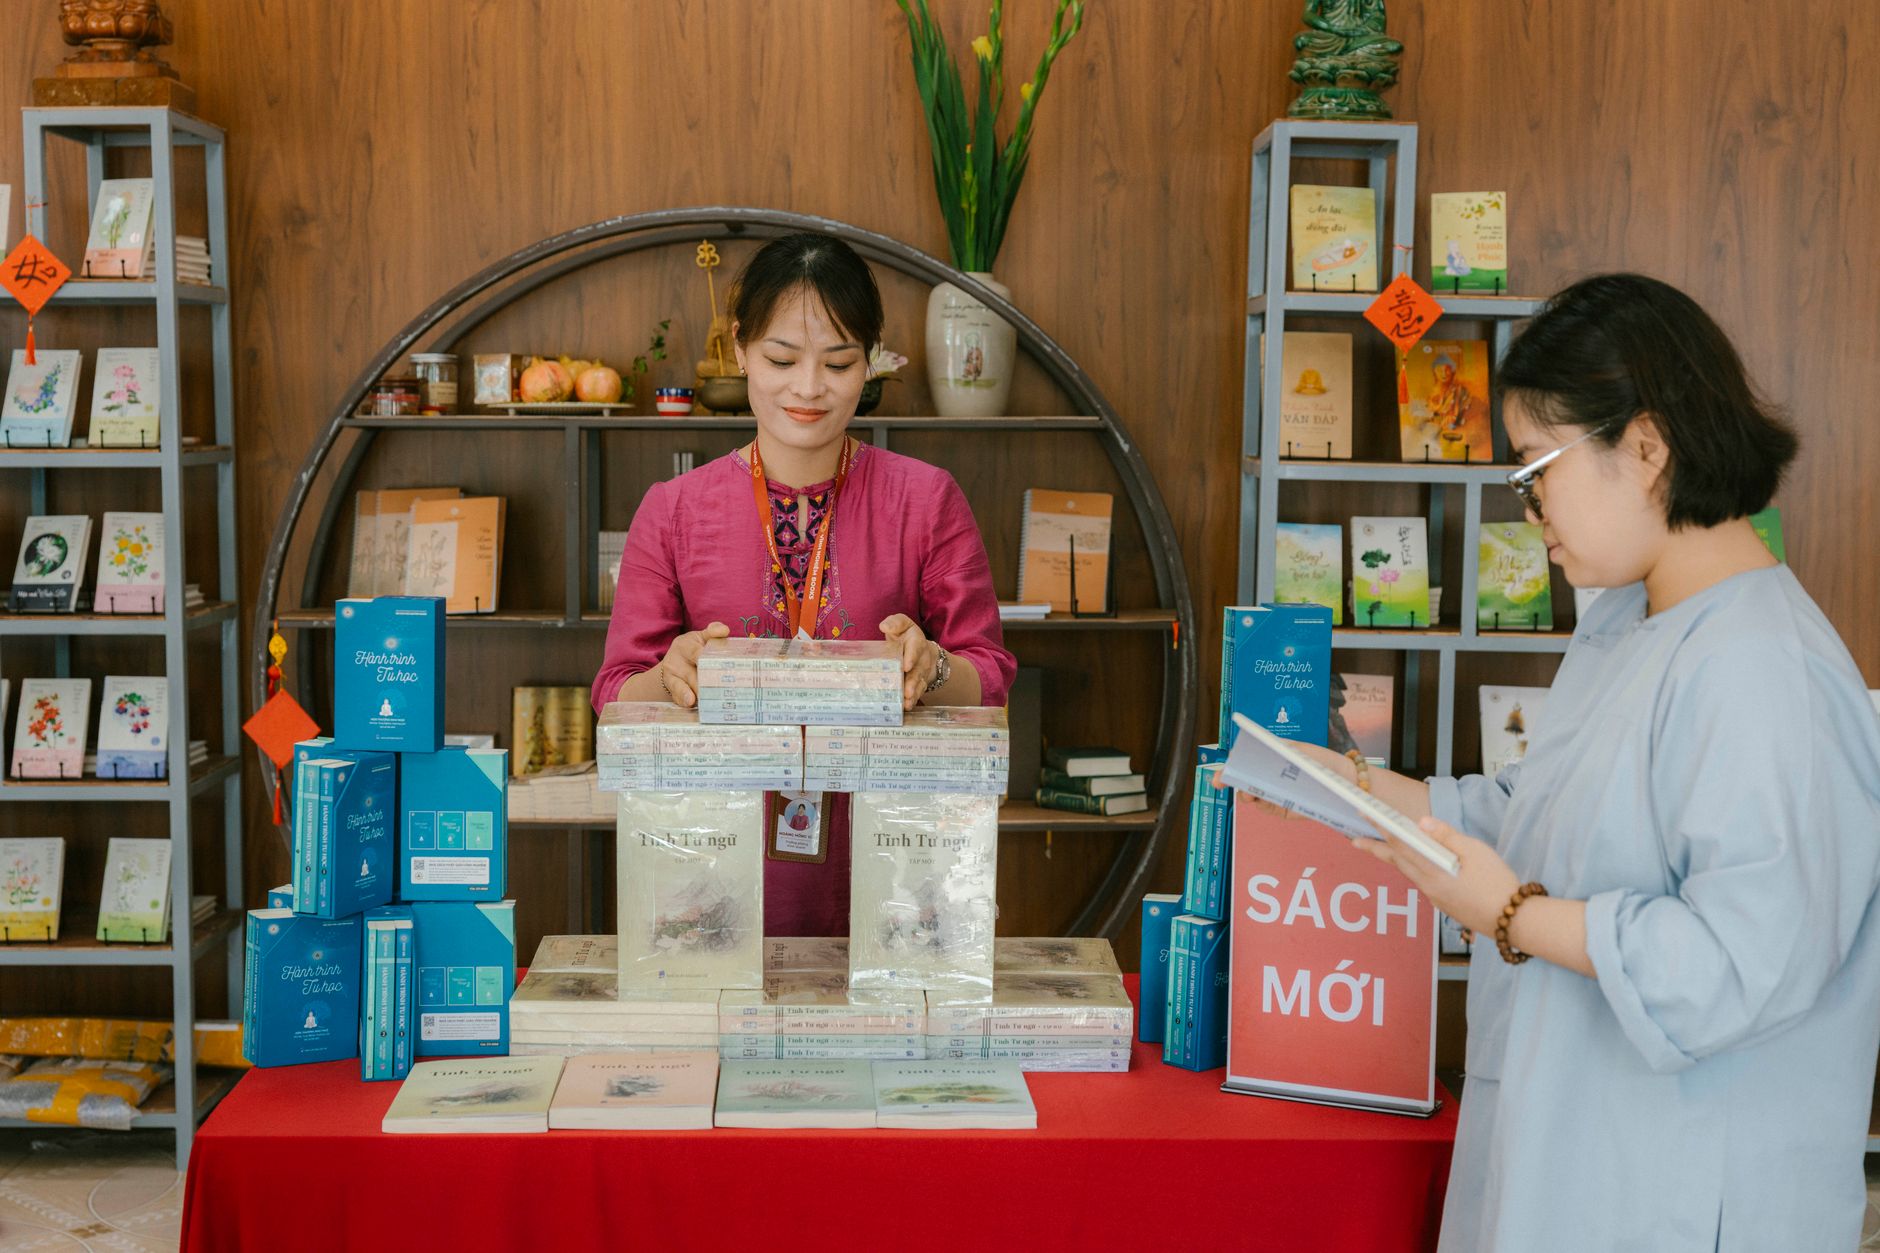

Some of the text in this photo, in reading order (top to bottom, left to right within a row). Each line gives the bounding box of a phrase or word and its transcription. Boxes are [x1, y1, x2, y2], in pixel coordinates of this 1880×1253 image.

[11, 254, 57, 289] 如
[1388, 289, 1424, 338] 意
[812, 550, 821, 576] NGHIÊM
[808, 576, 817, 600] BOOKS
[355, 650, 416, 667] Hành trình
[1255, 660, 1312, 675] Hành trình
[376, 666, 418, 684] Tu học
[1275, 674, 1314, 691] Tu học
[347, 808, 384, 831] Hành trình
[359, 825, 385, 843] Tu học
[707, 833, 738, 851] ngữ
[873, 832, 911, 848] Tĩnh
[915, 833, 938, 848] Tư
[1214, 846, 1220, 854] TU
[1245, 866, 1418, 938] SÁCH
[281, 963, 342, 982] Hành trình
[381, 967, 389, 987] HÀNH
[399, 966, 407, 987] HÀNH
[302, 978, 343, 995] Tu học
[1262, 959, 1385, 1027] MỚI
[381, 1006, 387, 1015] TU
[399, 1006, 405, 1015] TU
